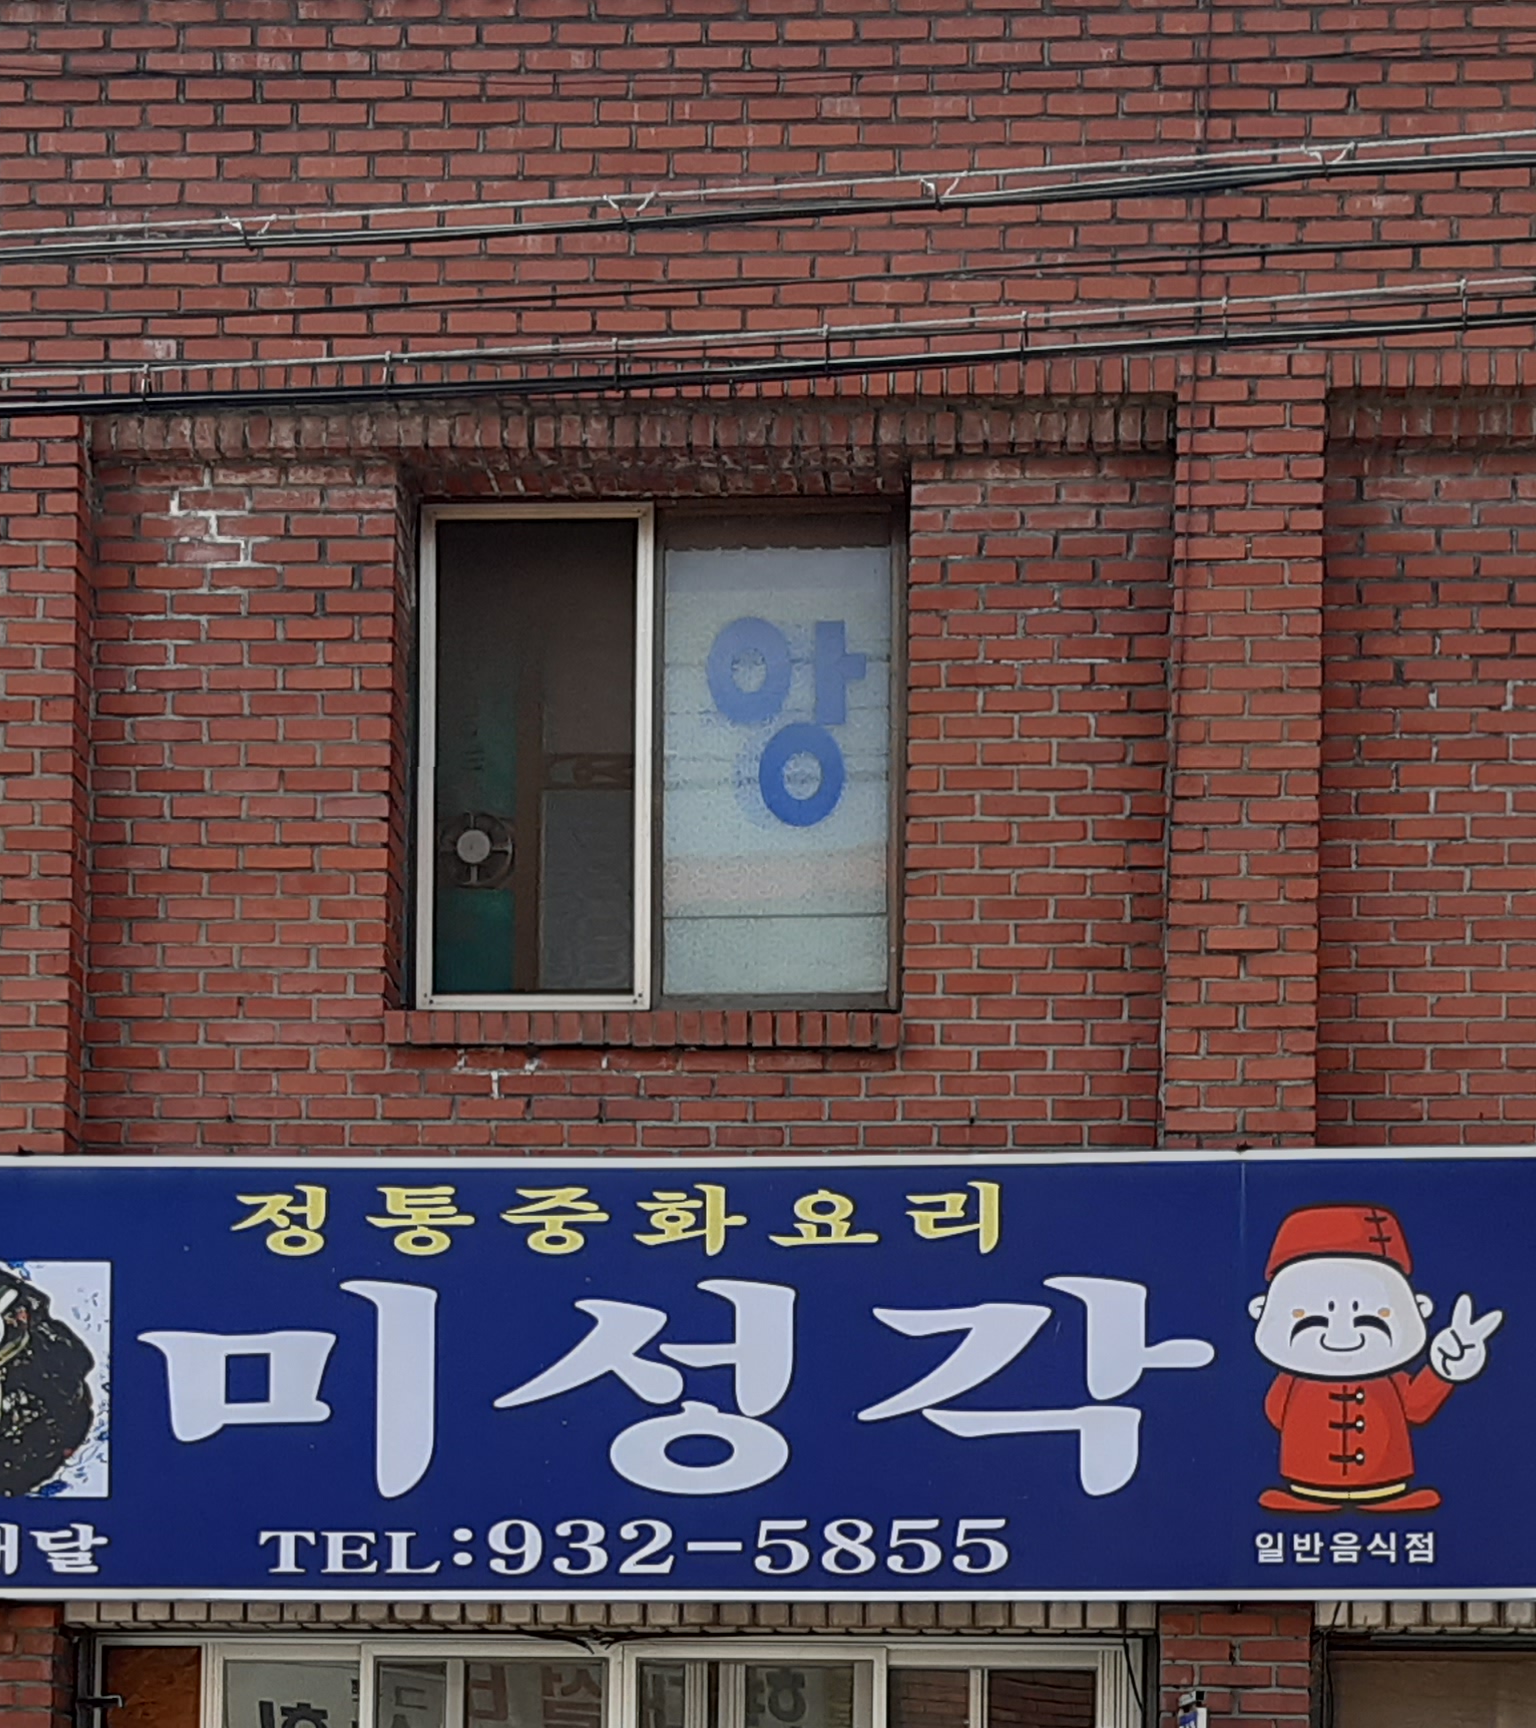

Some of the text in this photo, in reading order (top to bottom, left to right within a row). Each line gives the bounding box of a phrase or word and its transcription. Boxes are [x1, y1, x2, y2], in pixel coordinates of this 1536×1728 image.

[707, 616, 866, 827] 앙
[230, 1181, 1000, 1257] 정통중화요리
[136, 1276, 1216, 1499] 미성각
[259, 1516, 1011, 1575] TEL:932-5855
[1254, 1529, 1437, 1565] 일반음식점
